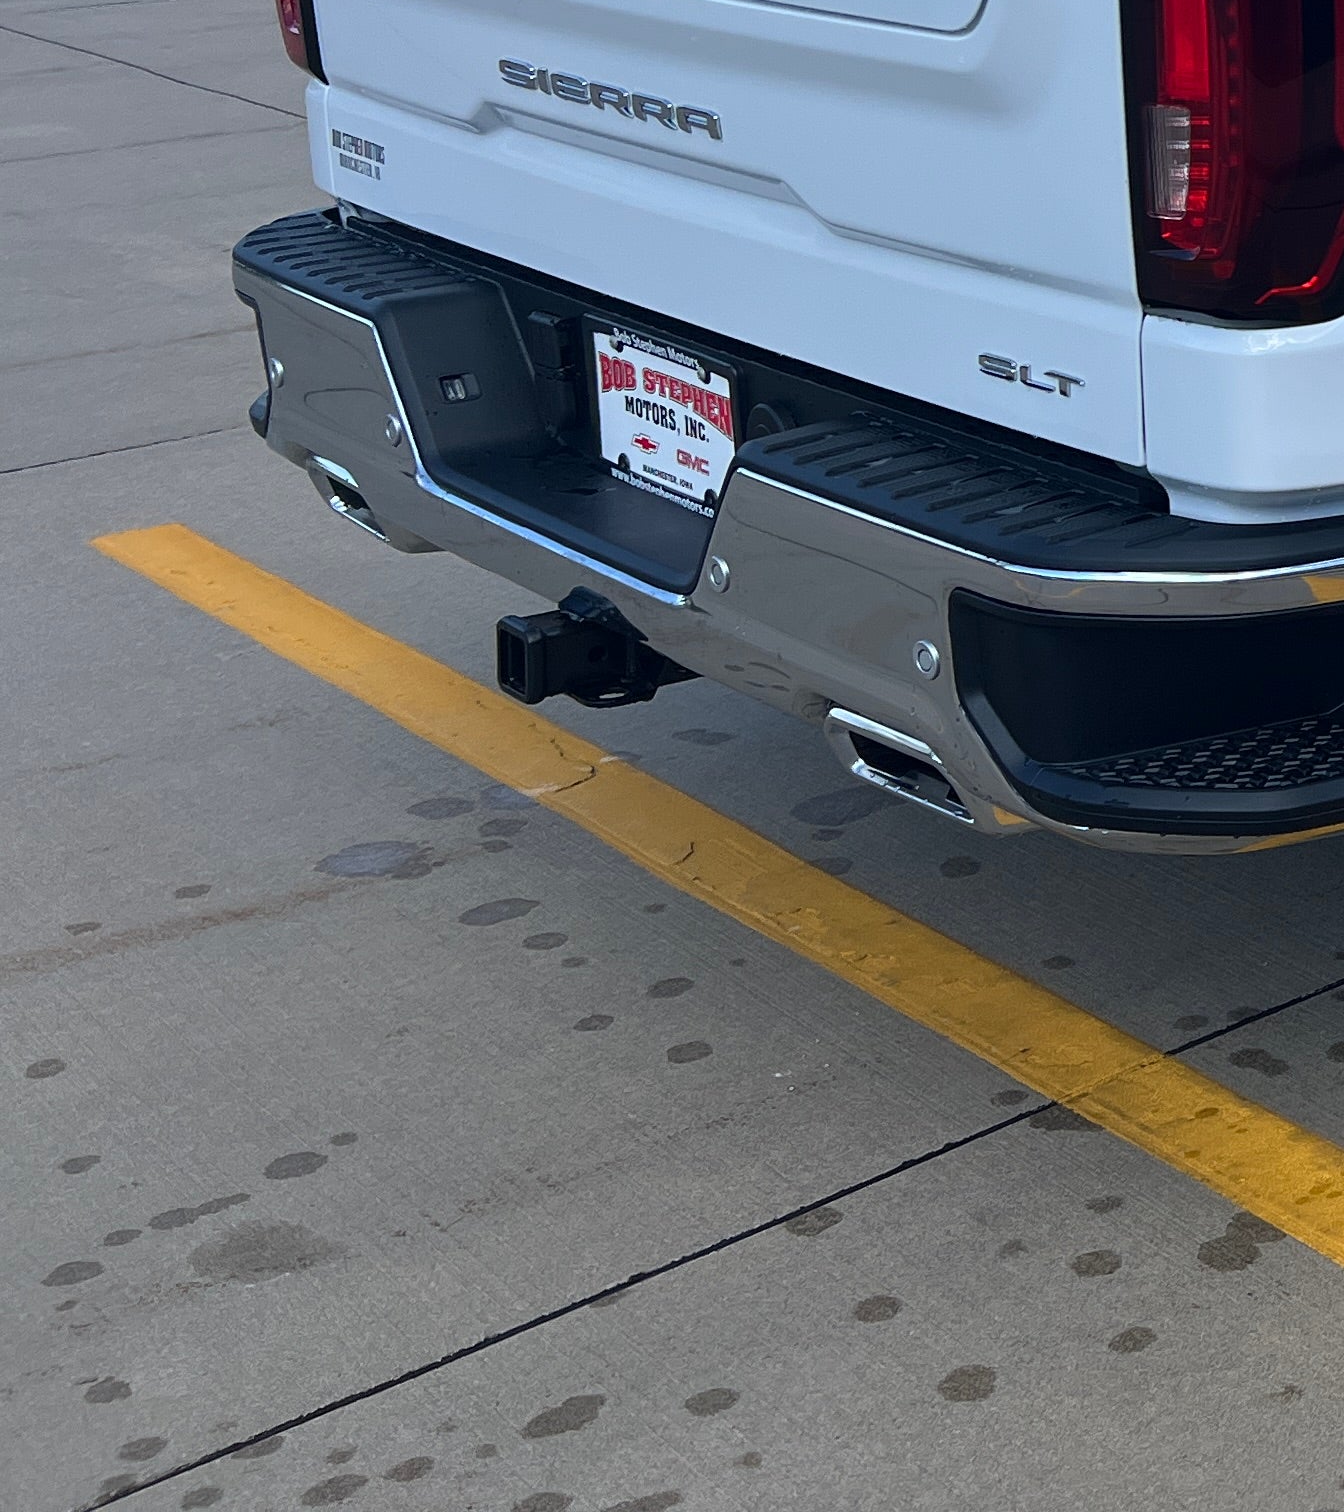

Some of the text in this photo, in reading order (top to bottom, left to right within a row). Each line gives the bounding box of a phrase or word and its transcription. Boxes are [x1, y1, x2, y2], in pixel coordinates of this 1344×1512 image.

[499, 56, 723, 142] SIERRA
[631, 333, 667, 358] Stephen
[667, 346, 700, 370] Motors
[978, 351, 1086, 398] SLT
[598, 351, 733, 441] BOB STEPHEN
[625, 395, 710, 443] MOTORS, INC.
[676, 448, 710, 477] GMC
